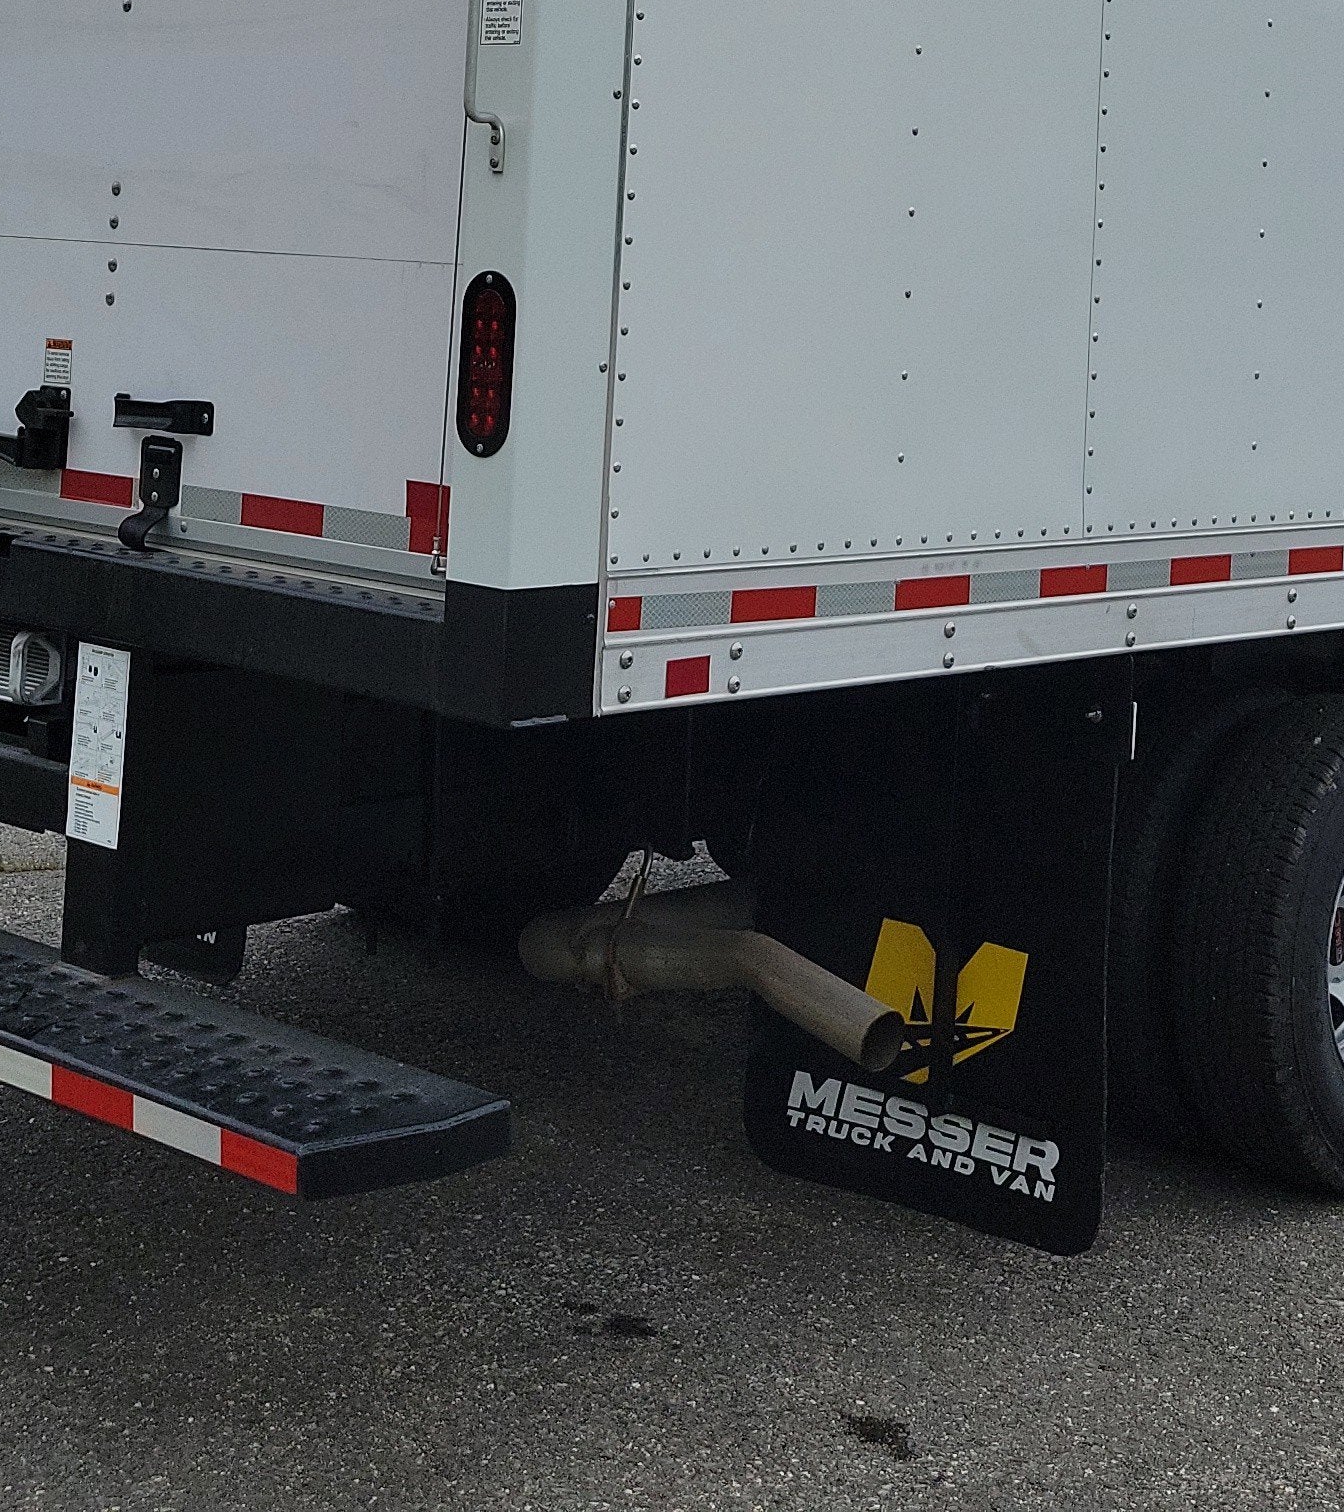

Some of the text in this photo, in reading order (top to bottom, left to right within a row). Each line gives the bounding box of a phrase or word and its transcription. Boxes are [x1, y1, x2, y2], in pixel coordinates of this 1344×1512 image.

[787, 1070, 1059, 1182] MESSER
[787, 1109, 1056, 1202] TRUCK AND VAN
